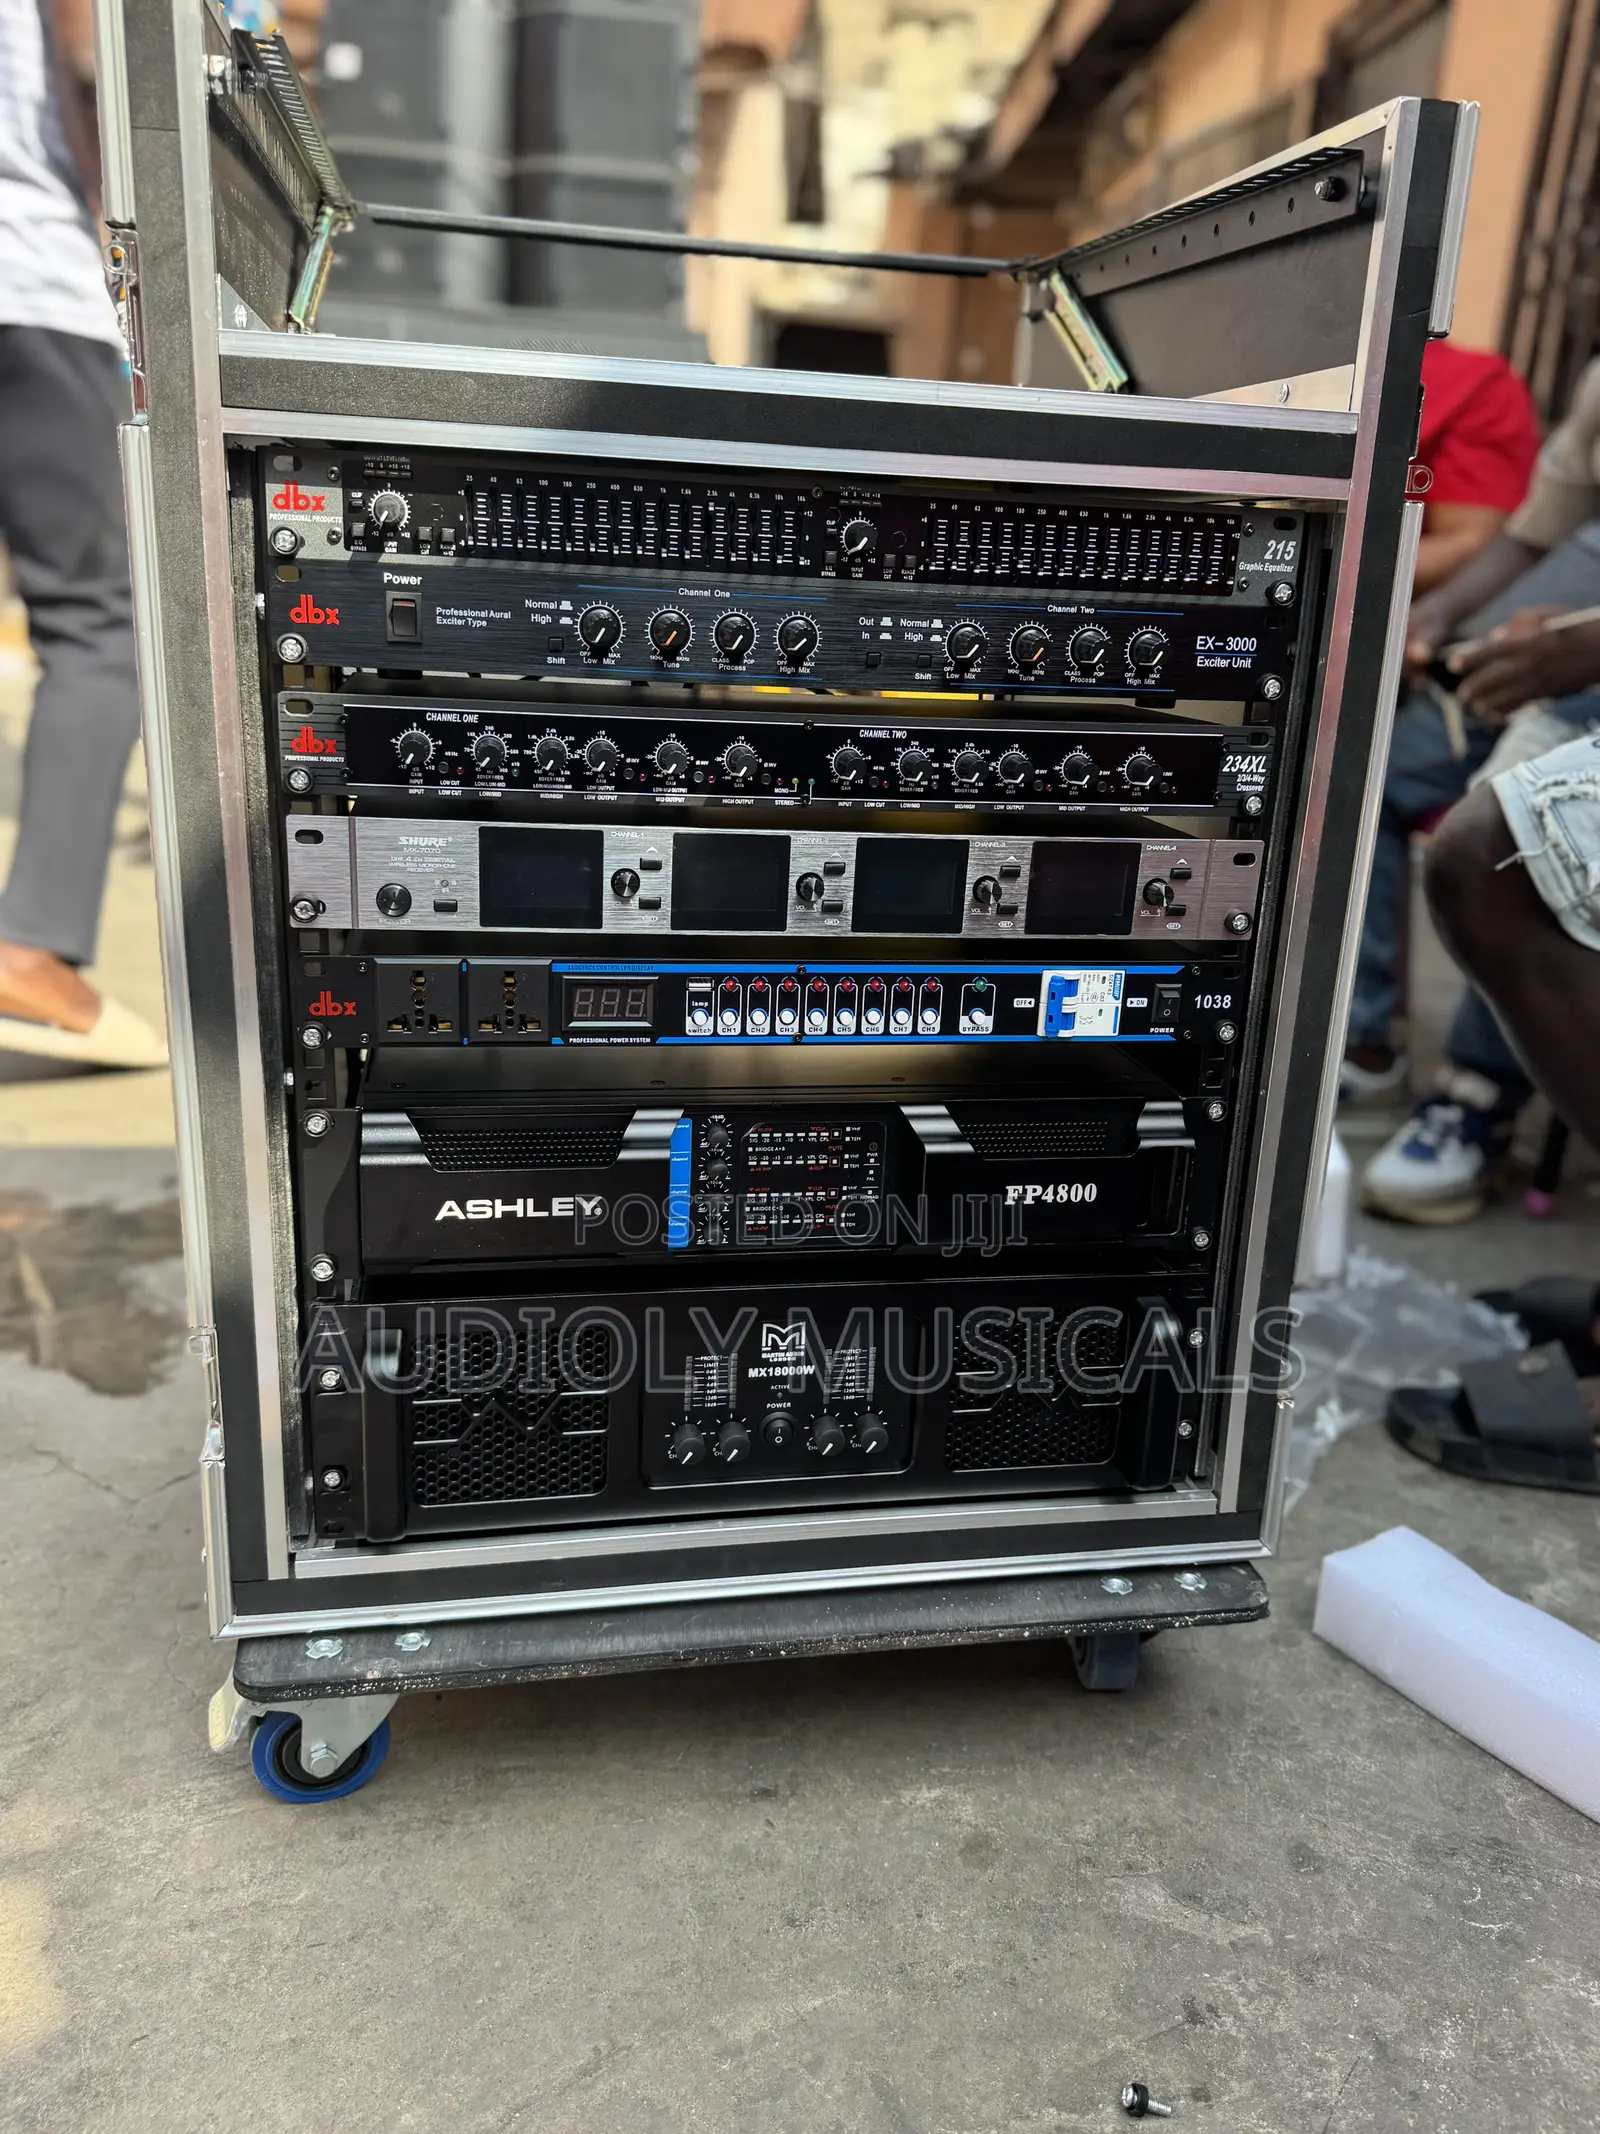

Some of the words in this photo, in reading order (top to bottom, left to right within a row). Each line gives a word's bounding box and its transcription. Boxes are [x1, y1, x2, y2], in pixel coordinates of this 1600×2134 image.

[272, 480, 326, 512] dbx
[270, 513, 313, 522] PROFESSIONAL
[314, 515, 342, 523] PRODUCTS
[1264, 540, 1296, 561] 215
[1239, 562, 1264, 572] Graphic
[1264, 563, 1294, 573] Equalizer
[384, 572, 422, 585] Power
[678, 588, 710, 597] Channel
[715, 590, 730, 598] One
[290, 594, 340, 624] dbx
[525, 600, 557, 609] Normal
[1048, 605, 1077, 613] Channel
[1080, 606, 1094, 614] Two
[436, 607, 487, 618] Professional
[489, 610, 511, 619] Aural
[436, 617, 466, 626] Exciter
[467, 618, 487, 628] Type
[531, 614, 551, 624] High
[859, 617, 874, 625] Out
[900, 618, 929, 628] Normal
[904, 632, 923, 642] High
[1196, 636, 1257, 651] EX-3000
[719, 663, 746, 672] Process
[1197, 656, 1230, 668] Exciter
[1232, 657, 1251, 668] Unit
[780, 666, 795, 674] High
[426, 712, 461, 723] CHANNEL
[463, 714, 478, 723] ONE
[860, 729, 890, 738] CHANNEL
[892, 731, 907, 739] TWO
[291, 726, 337, 754] dbx
[1222, 755, 1267, 773] 234XL
[1237, 774, 1265, 783] 2/3/4-Way
[1237, 783, 1264, 792] Crossover
[399, 836, 448, 848] SHURE
[309, 991, 357, 1017] dbx
[1194, 995, 1232, 1009] 1038
[1005, 1183, 1097, 1205] FP4800
[435, 1196, 602, 1220] ASHLEY
[749, 1365, 815, 1378] MX18000W
